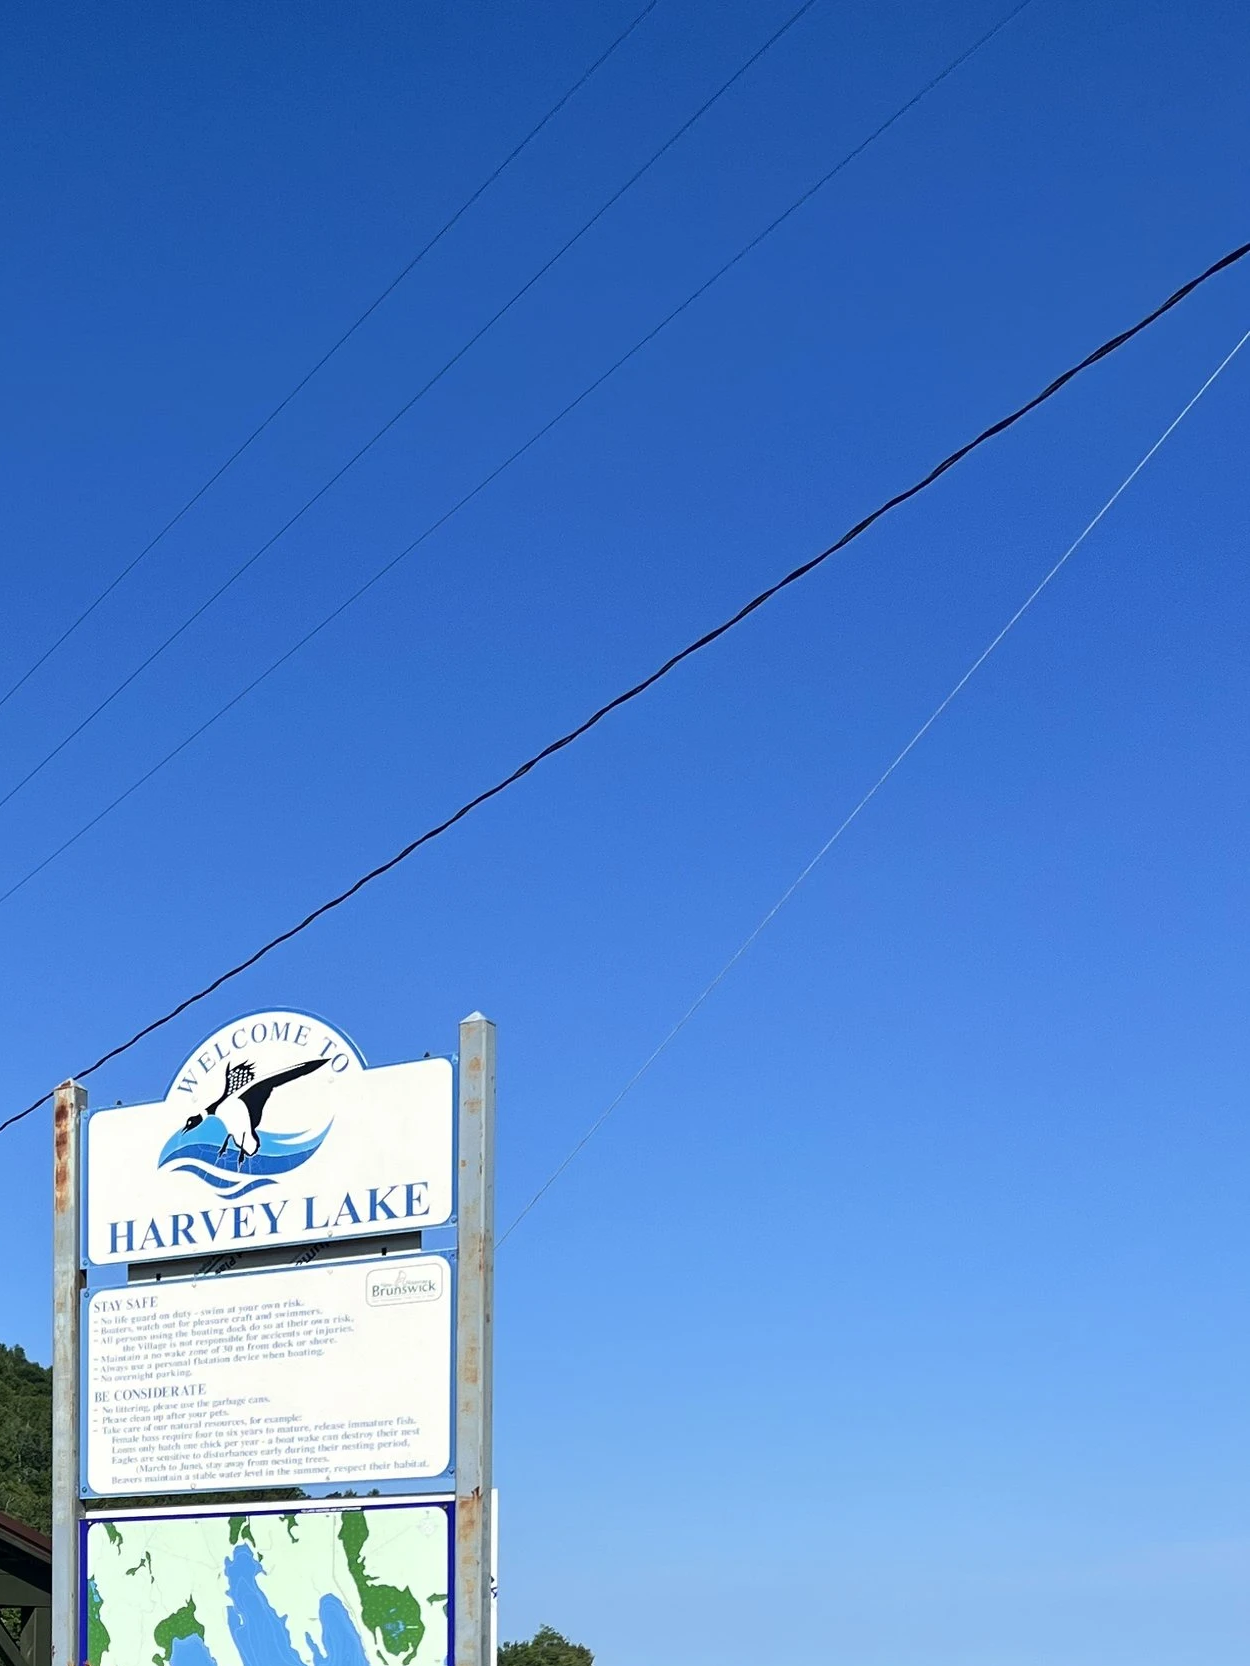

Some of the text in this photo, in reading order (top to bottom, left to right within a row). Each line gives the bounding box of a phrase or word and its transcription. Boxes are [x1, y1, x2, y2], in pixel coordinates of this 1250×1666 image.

[177, 1021, 350, 1094] WELCOME TO
[108, 1181, 431, 1254] HARVEY LAKE
[371, 1279, 436, 1298] Brunswick
[93, 1295, 158, 1313] STAY SAFE
[100, 1317, 112, 1325] No
[114, 1315, 128, 1324] life
[130, 1312, 157, 1324] guard
[172, 1310, 191, 1319] duty
[200, 1306, 224, 1316] swim
[226, 1305, 236, 1314] at
[238, 1304, 259, 1314] your
[260, 1302, 280, 1310] own
[136, 1321, 160, 1331] watch
[162, 1321, 176, 1329] out
[178, 1319, 190, 1328] for
[192, 1317, 229, 1329] pleasure
[231, 1313, 252, 1323] craft
[255, 1311, 272, 1321] and
[100, 1335, 113, 1344] All
[115, 1335, 147, 1345] persons
[149, 1331, 173, 1340] using
[175, 1329, 187, 1338] the
[190, 1326, 224, 1336] boating
[226, 1323, 247, 1333] dock
[248, 1322, 261, 1331] do
[275, 1321, 284, 1329] at
[286, 1319, 308, 1328] their
[122, 1344, 135, 1352] the
[137, 1341, 167, 1351] Village
[169, 1339, 176, 1348] is
[179, 1339, 193, 1347] not
[195, 1334, 243, 1347] responsible
[245, 1332, 259, 1344] for
[101, 1353, 141, 1363] Maintain
[163, 1349, 186, 1358] wake
[188, 1348, 208, 1356] zone
[210, 1345, 220, 1354] of
[247, 1342, 269, 1351] from
[271, 1339, 294, 1349] dock
[295, 1339, 306, 1347] or
[100, 1365, 128, 1373] Always
[130, 1363, 144, 1371] use
[154, 1358, 191, 1371] personal
[193, 1356, 231, 1366] flotation
[232, 1352, 260, 1362] device
[262, 1351, 285, 1359] when
[114, 1371, 153, 1381] overnight
[94, 1383, 207, 1403] BE CONSIDERATE
[152, 1402, 178, 1412] please
[196, 1399, 209, 1408] the
[211, 1397, 246, 1408] garbage
[102, 1416, 127, 1425] Please
[129, 1414, 151, 1423] clean
[153, 1414, 164, 1422] up
[166, 1411, 186, 1420] after
[188, 1411, 207, 1420] your
[102, 1426, 120, 1435] Take
[143, 1423, 152, 1432] of
[170, 1420, 202, 1430] natural
[249, 1416, 262, 1425] for
[111, 1434, 139, 1444] Female
[161, 1431, 192, 1441] require
[195, 1430, 213, 1439] four
[214, 1430, 224, 1438] to
[226, 1428, 238, 1437] six
[240, 1428, 263, 1437] years
[313, 1421, 345, 1431] release
[347, 1419, 393, 1429] immature
[138, 1443, 155, 1453] only
[199, 1439, 222, 1449] chick
[223, 1440, 239, 1449] per
[240, 1439, 259, 1448] year
[275, 1435, 295, 1444] boat
[297, 1433, 320, 1442] wake
[321, 1433, 339, 1441] can
[340, 1431, 373, 1440] destroy
[376, 1428, 398, 1438] their
[111, 1455, 138, 1465] Eagles
[156, 1452, 190, 1461] sensitive
[192, 1452, 201, 1460] to
[202, 1448, 258, 1459] disturbances
[260, 1446, 282, 1456] early
[284, 1445, 316, 1454] during
[317, 1443, 339, 1452] their
[341, 1441, 375, 1451] nesting
[205, 1461, 221, 1469] stay
[223, 1460, 244, 1468] away
[247, 1458, 269, 1467] from
[270, 1457, 303, 1465] nesting
[111, 1476, 142, 1485] Beavers
[144, 1474, 182, 1483] maintain
[192, 1471, 216, 1480] stable
[218, 1471, 242, 1479] water
[244, 1468, 263, 1478] level
[265, 1468, 274, 1476] in
[276, 1467, 291, 1475] the
[333, 1463, 367, 1473] respect
[369, 1461, 391, 1470] their
